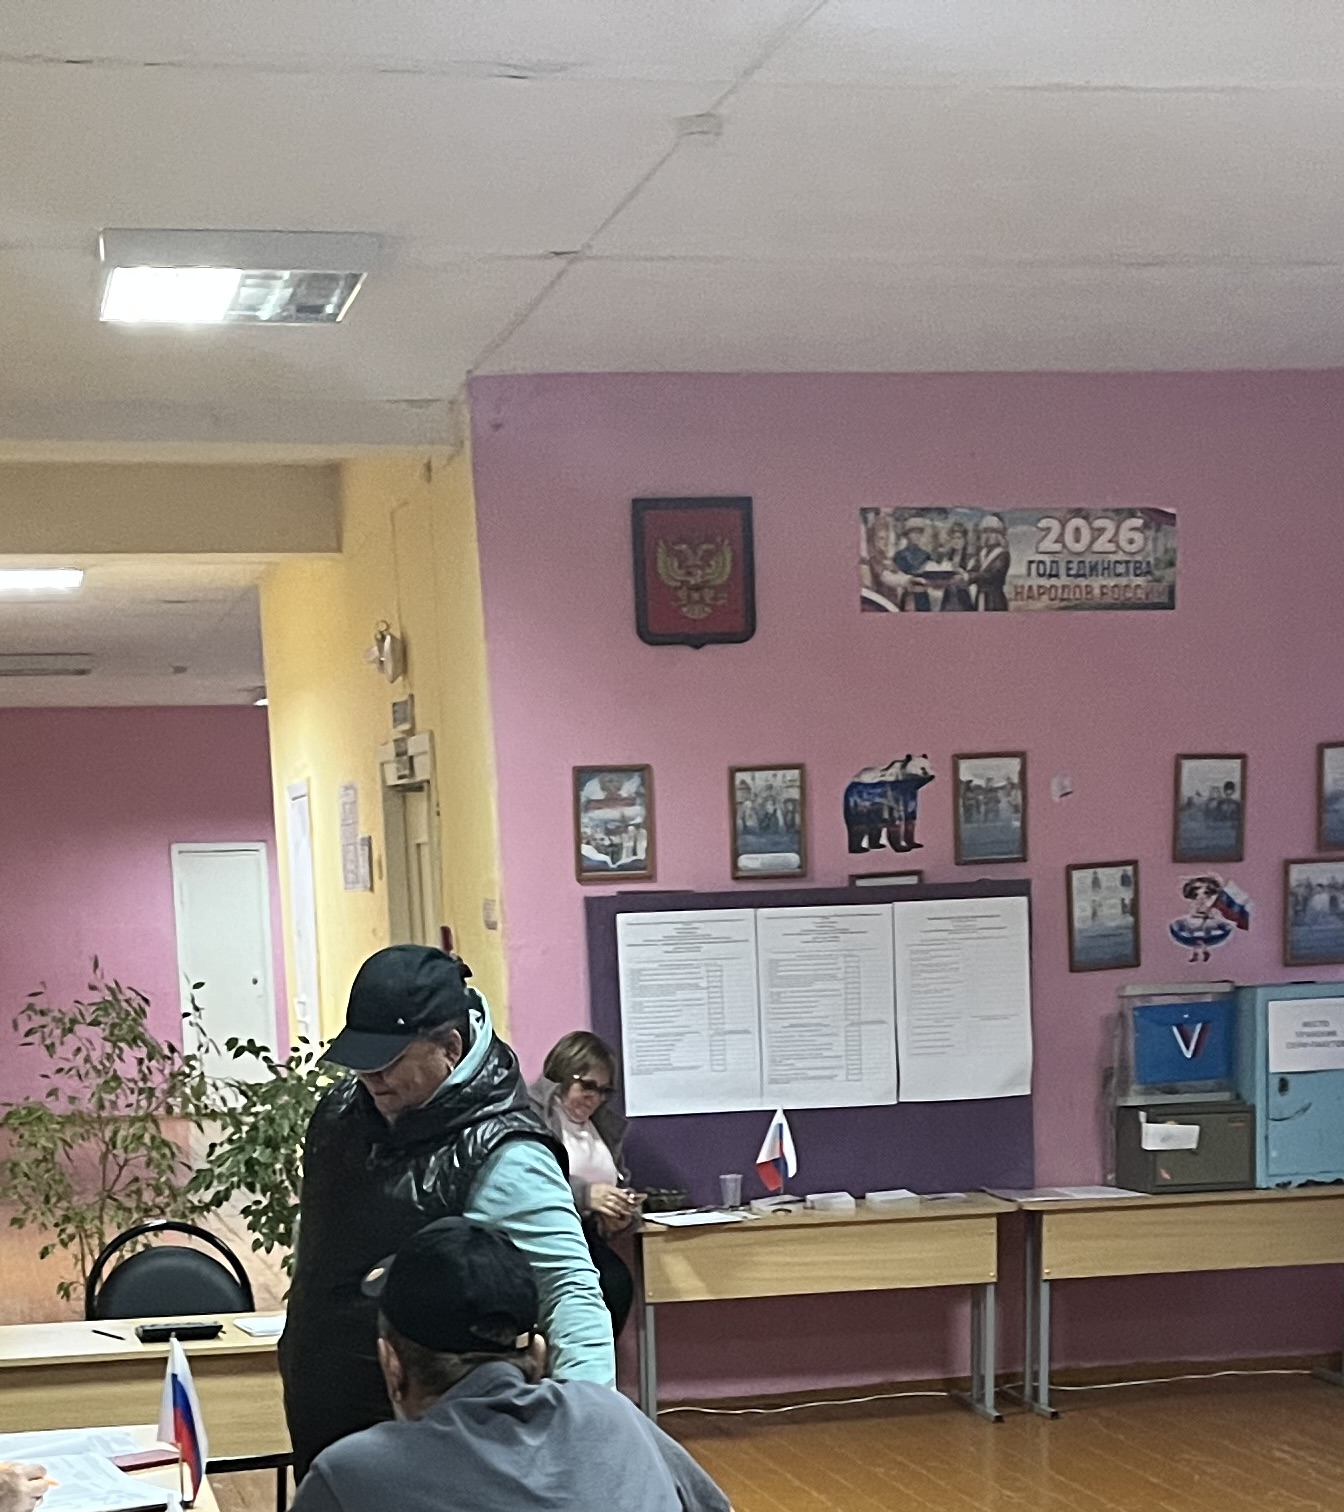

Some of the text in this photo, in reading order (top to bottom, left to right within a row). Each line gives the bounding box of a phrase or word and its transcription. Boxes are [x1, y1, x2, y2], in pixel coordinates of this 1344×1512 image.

[1036, 516, 1145, 554] 2026
[1027, 560, 1153, 579] ГОД ЕДИНСТВА
[1014, 584, 1093, 602] НАРОДОВ
